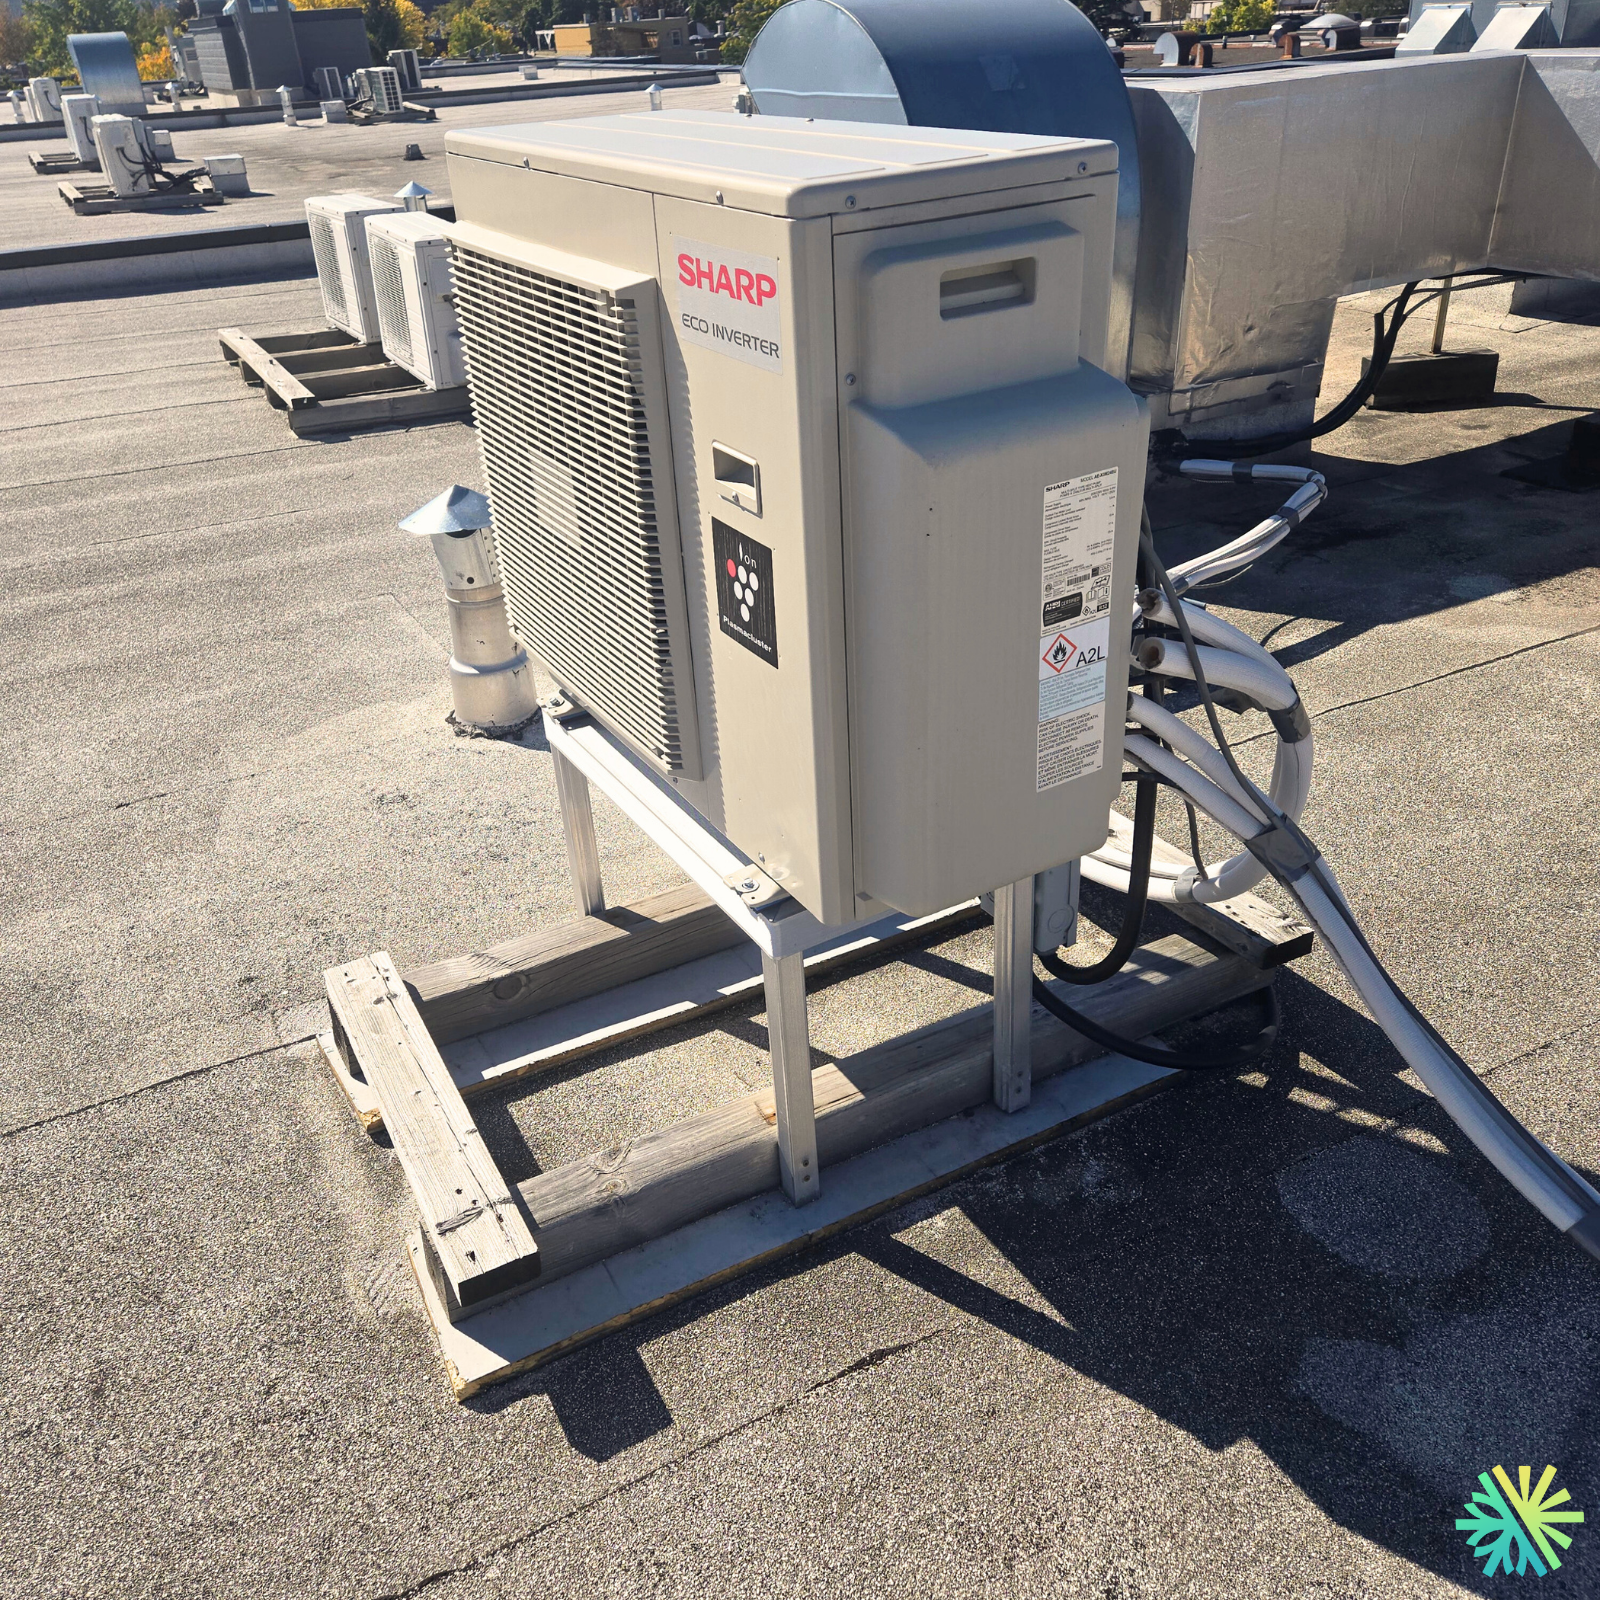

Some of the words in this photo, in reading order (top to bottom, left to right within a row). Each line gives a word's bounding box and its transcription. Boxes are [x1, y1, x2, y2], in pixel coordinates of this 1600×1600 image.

[678, 253, 777, 307] SHARP
[682, 313, 709, 334] ECO
[712, 323, 780, 358] INVERTER
[1046, 482, 1070, 492] SHARP
[722, 615, 773, 653] Plasmacluster
[1076, 646, 1106, 667] A2L
